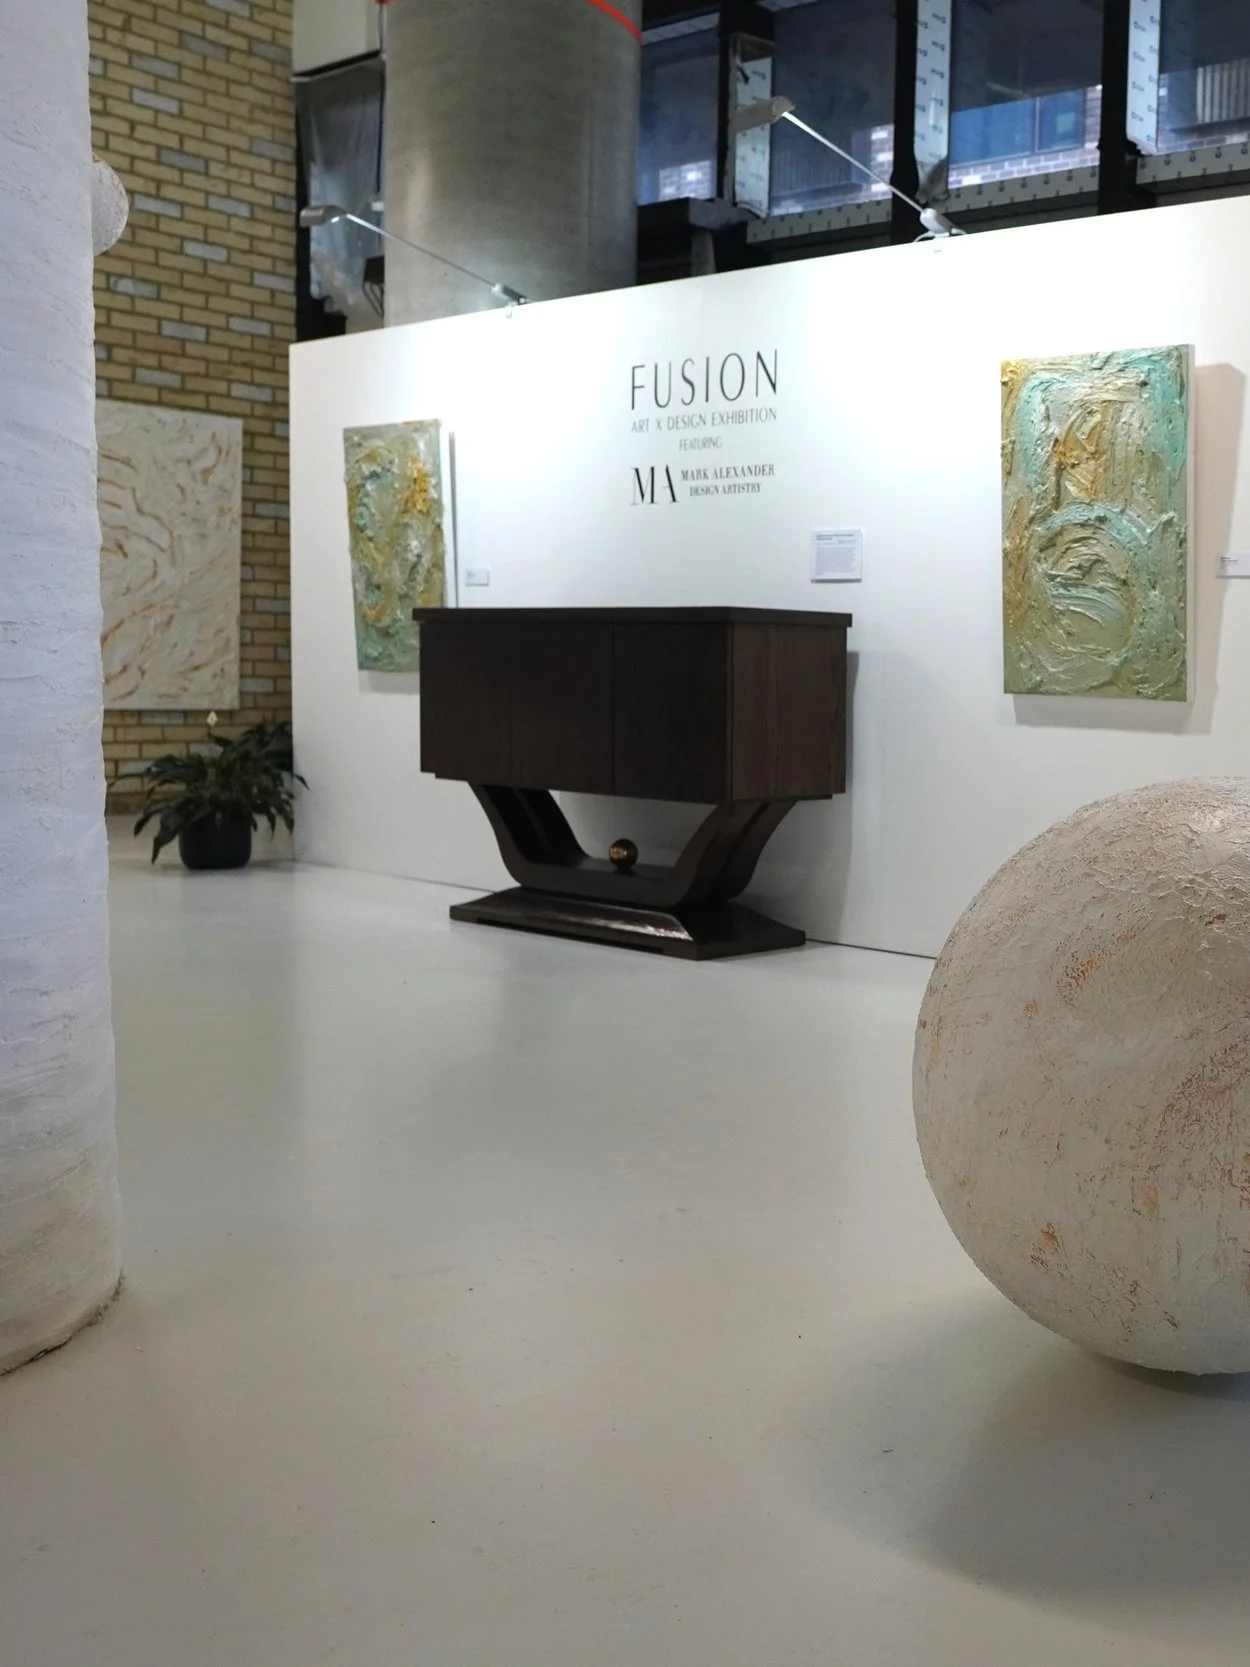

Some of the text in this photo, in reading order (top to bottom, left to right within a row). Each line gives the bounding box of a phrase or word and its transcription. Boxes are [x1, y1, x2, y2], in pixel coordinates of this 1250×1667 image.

[632, 349, 777, 410] FUSION
[631, 407, 778, 433] ART X DESIGN EXHIBITION
[679, 436, 722, 451] FEATURING
[681, 464, 775, 481] MARK ALEXANDER
[630, 464, 679, 506] MA
[690, 482, 762, 497] DESIGN ARTISTRY
